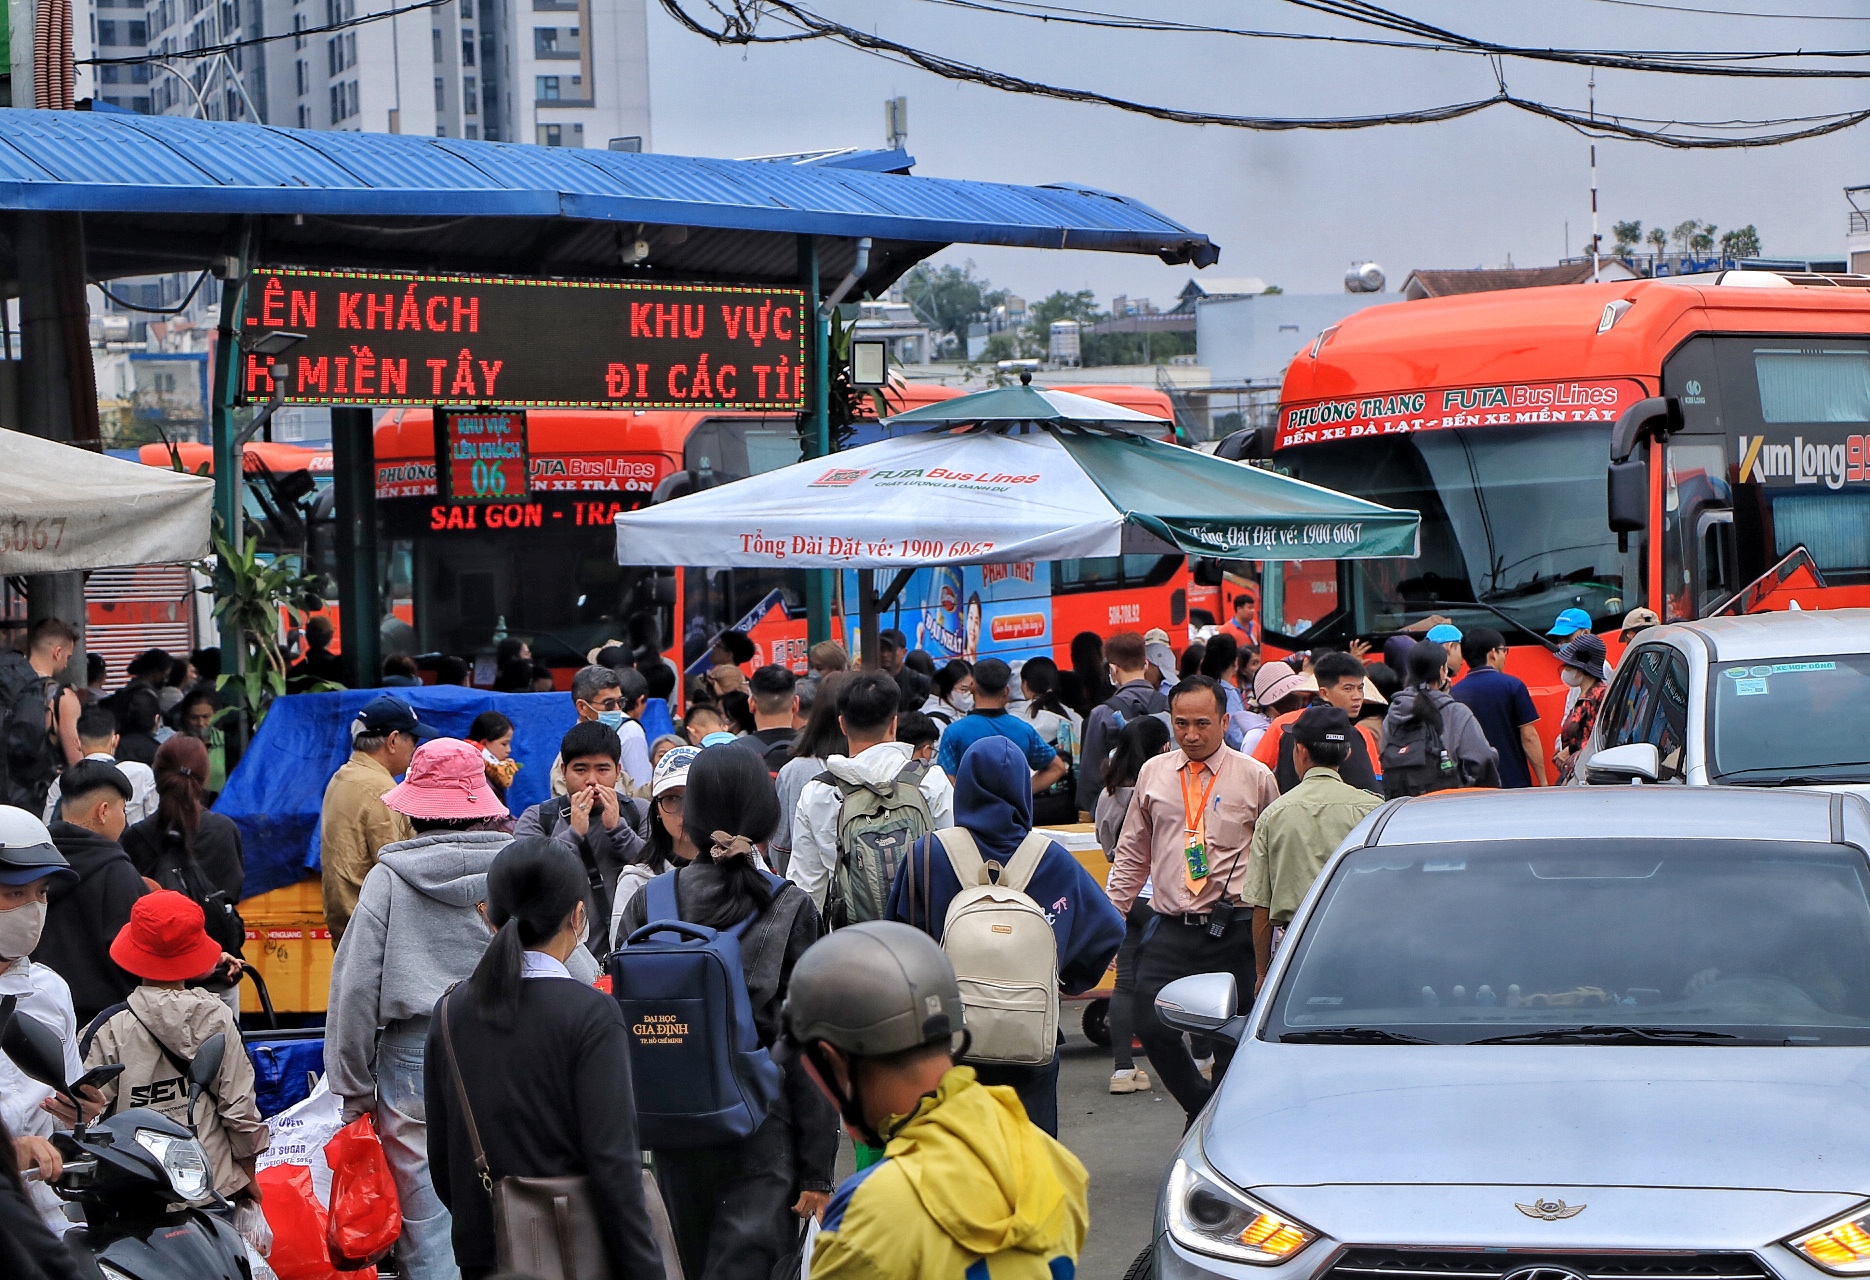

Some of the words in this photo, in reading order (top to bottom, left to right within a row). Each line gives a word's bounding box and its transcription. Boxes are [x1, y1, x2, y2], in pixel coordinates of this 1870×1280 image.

[247, 277, 317, 328] ÊN
[338, 283, 480, 333] KHÁCH
[630, 302, 705, 339] KHU
[721, 299, 793, 348] VỰC
[297, 345, 408, 395] MIỀN
[426, 348, 503, 396] TÂY
[605, 363, 649, 398] ĐI
[667, 353, 737, 399] CÁC
[1287, 401, 1356, 430] PHƯƠNG
[1360, 393, 1426, 420] TRANG
[1442, 386, 1510, 412] FUTA
[1511, 384, 1554, 408] Bus
[1555, 383, 1618, 406] Lines
[457, 417, 483, 434] KHU
[485, 415, 511, 437] VỰC
[1283, 428, 1318, 447] BẾN
[1320, 426, 1347, 441] XE
[1383, 417, 1425, 434] LẠT
[1441, 411, 1480, 428] BẾN
[1484, 412, 1511, 425] XE
[1515, 406, 1569, 424] MIỀN
[1571, 406, 1617, 422] TÂY
[453, 438, 477, 459] LÊN
[479, 437, 521, 459] KHÁCH
[471, 459, 506, 496] 06
[529, 459, 566, 476] UTA
[569, 458, 603, 476] Bus
[604, 459, 655, 478] Lines
[868, 468, 925, 480] FUTA
[926, 467, 974, 481] Bus
[974, 472, 1041, 484] Lines
[401, 485, 420, 496] XE
[552, 480, 578, 490] XE
[625, 478, 654, 492] ÔN
[430, 504, 477, 530] SAI
[484, 502, 543, 528] GON
[739, 528, 787, 559] Tổng
[791, 534, 823, 556] Đài
[828, 536, 862, 560] Đặt
[867, 538, 894, 557] vé:
[900, 539, 944, 558] 1900
[948, 541, 994, 558] 6067
[1252, 524, 1277, 551] Đặt
[1279, 524, 1299, 545] vé:
[1302, 523, 1330, 544] 1900
[1332, 522, 1363, 544] 6067
[267, 930, 302, 939] HENGUANG
[632, 1023, 656, 1036] GIA
[656, 1023, 689, 1037] ĐỊNH
[643, 1015, 658, 1024] ĐẠI
[658, 1014, 677, 1024] HỌC
[278, 1144, 306, 1155] SUGAR
